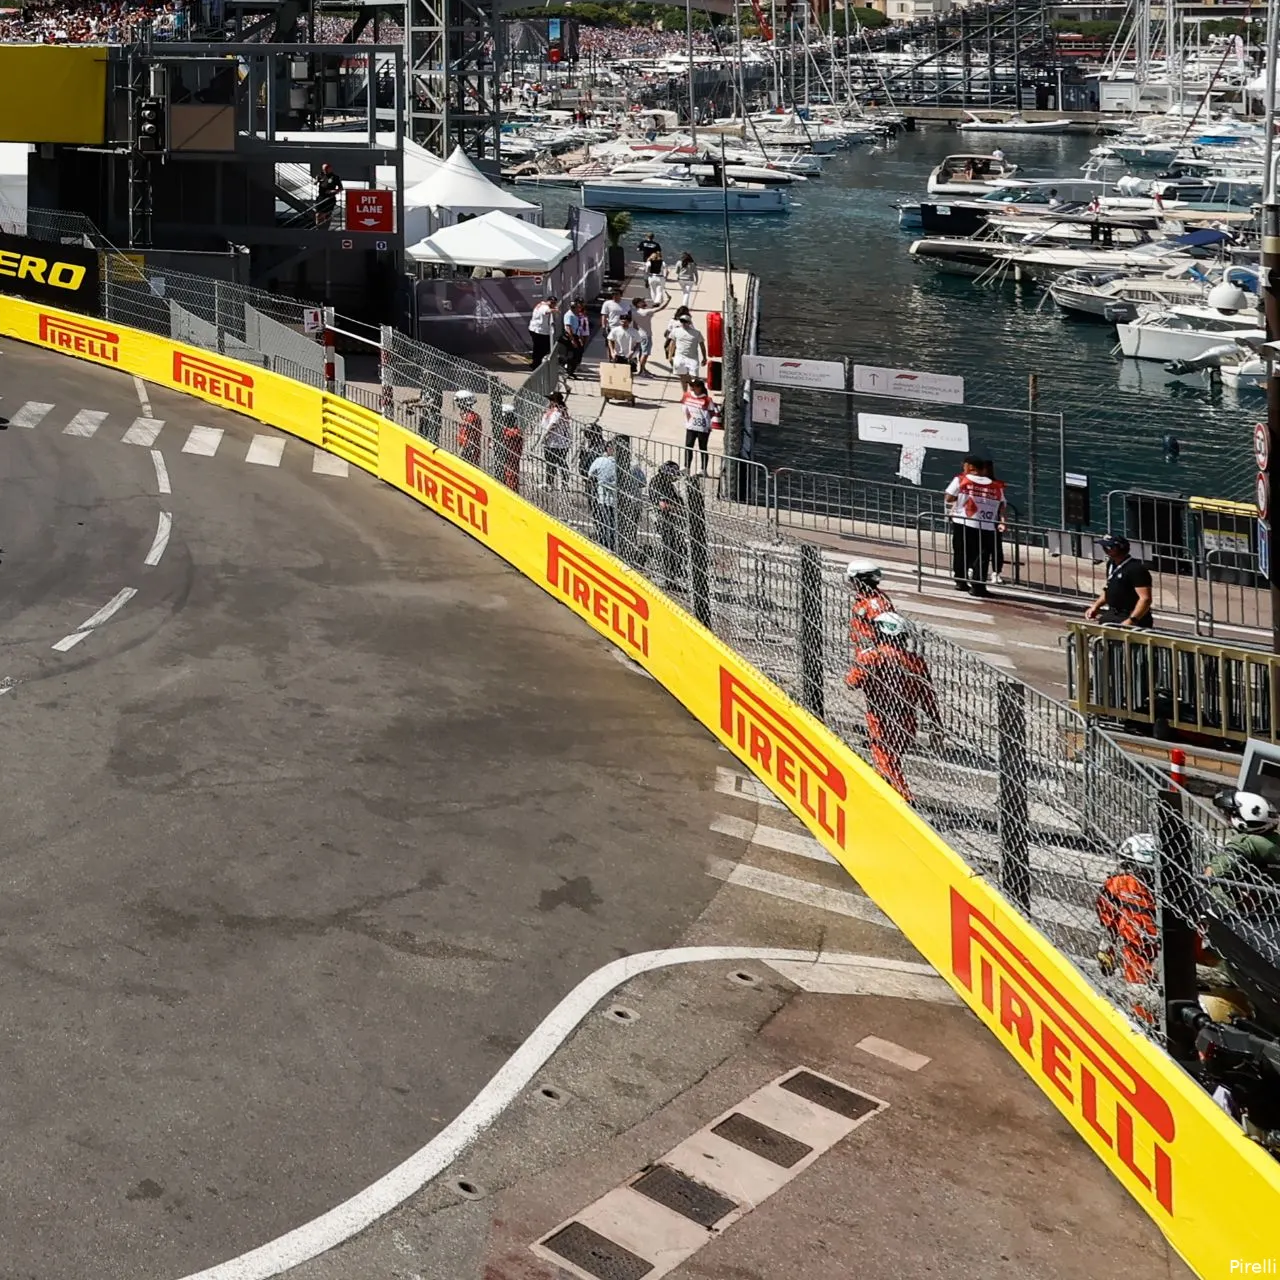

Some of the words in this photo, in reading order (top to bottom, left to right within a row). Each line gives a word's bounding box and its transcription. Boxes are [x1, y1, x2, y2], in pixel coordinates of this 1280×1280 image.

[356, 205, 383, 214] LANE
[361, 196, 378, 205] PIT
[38, 314, 120, 364] PIRELLI
[172, 350, 255, 410] PIRELLI
[405, 444, 489, 537] PIRELLI
[545, 532, 651, 660] PIRELLI
[717, 665, 849, 851] PIRELLI
[949, 884, 1177, 1217] PIRELLI
